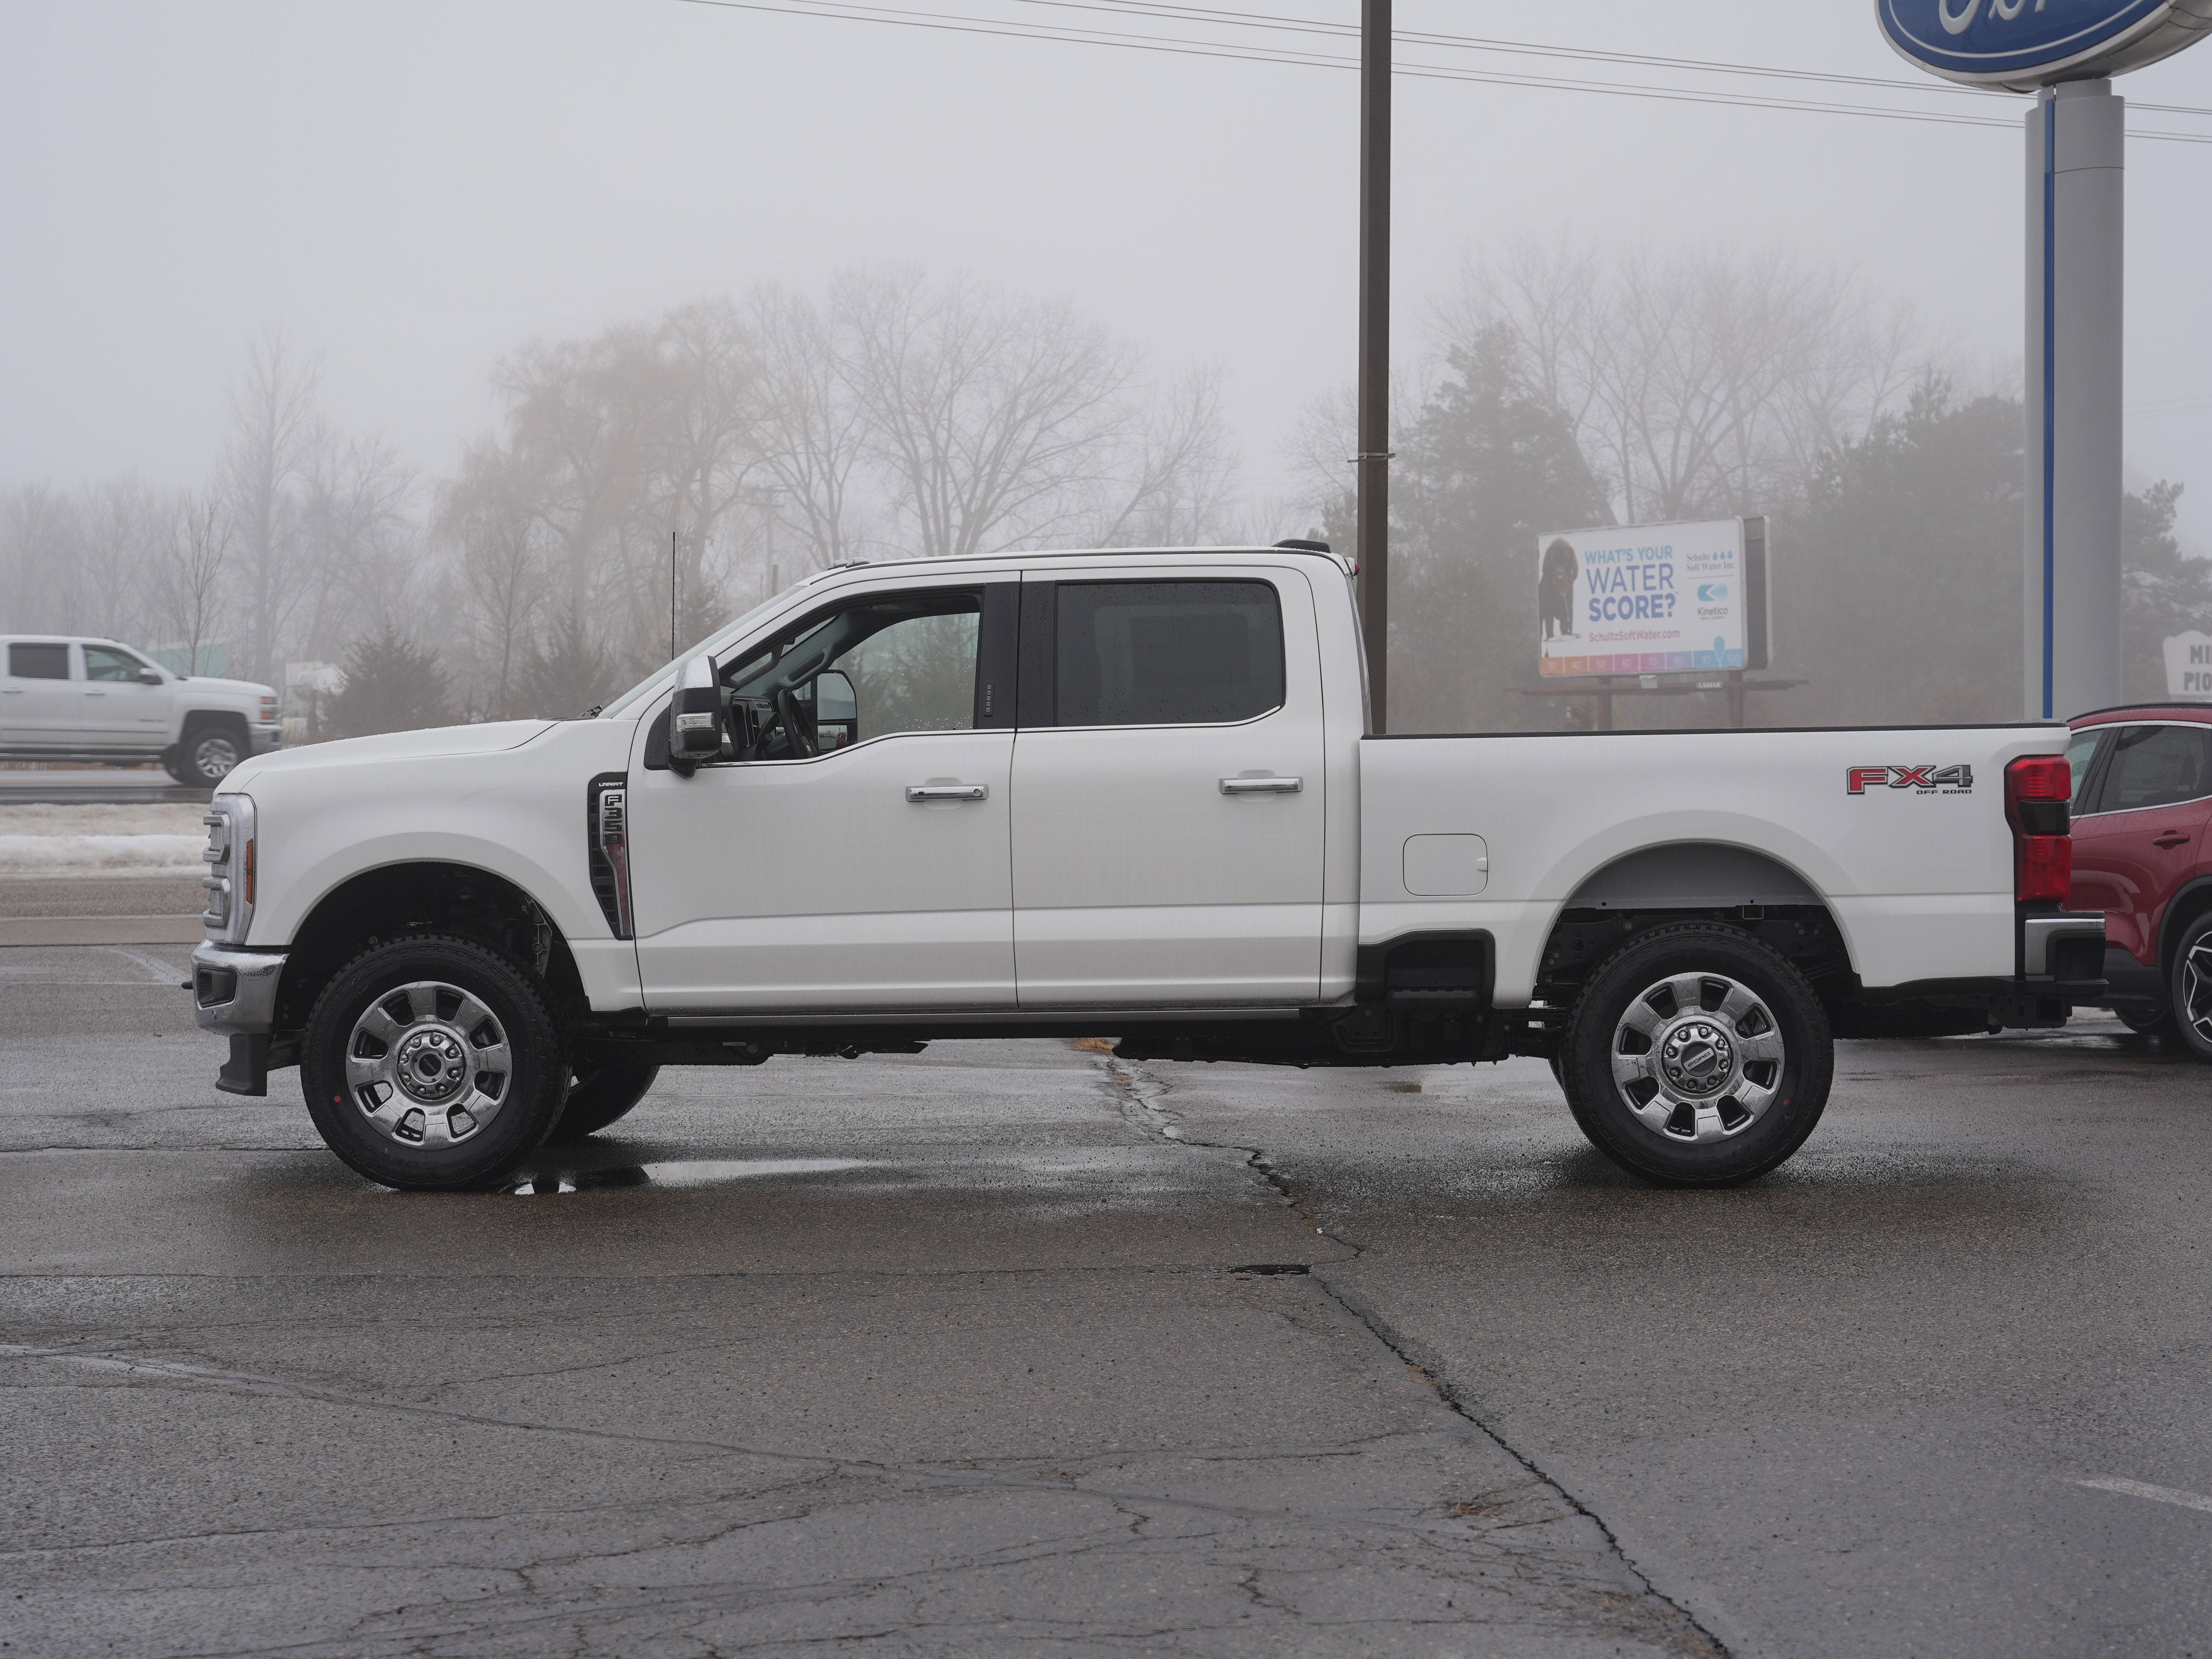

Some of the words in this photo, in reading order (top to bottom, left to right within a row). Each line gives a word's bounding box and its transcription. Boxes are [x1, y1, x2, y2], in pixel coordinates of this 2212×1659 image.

[1584, 548, 1634, 565] WHAT'S
[1637, 545, 1673, 561] YOUR
[1687, 552, 1710, 562] Schultz
[1687, 563, 1700, 571] Soft
[1702, 561, 1721, 570] Water
[1724, 561, 1735, 569] Inc
[1586, 563, 1674, 594] WATER
[1589, 593, 1676, 622] SCORE?
[1697, 606, 1728, 616] Kinetico
[1589, 630, 1680, 642] SchultzSoftWater.com
[2190, 644, 2212, 664] MI
[1572, 660, 1581, 670] 40
[2184, 671, 2212, 692] PIO
[1847, 765, 1973, 795] FX4
[1688, 1052, 1710, 1067] FORD
